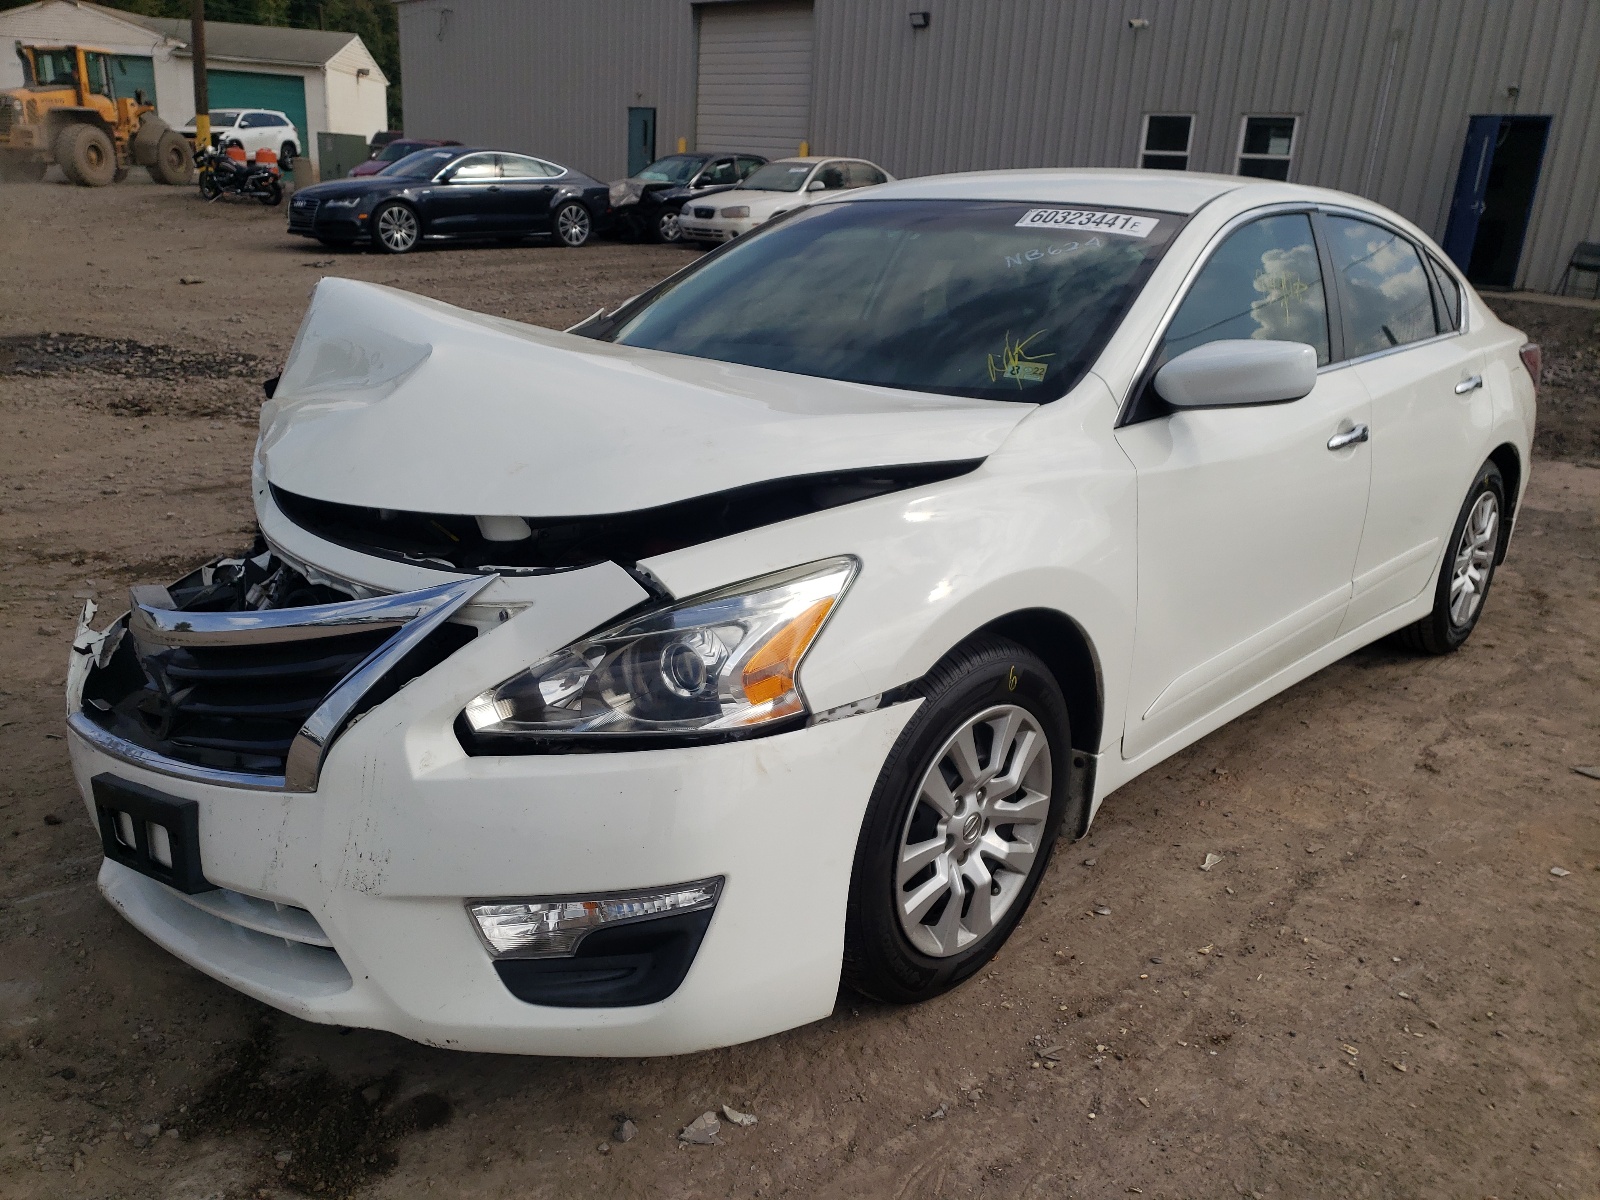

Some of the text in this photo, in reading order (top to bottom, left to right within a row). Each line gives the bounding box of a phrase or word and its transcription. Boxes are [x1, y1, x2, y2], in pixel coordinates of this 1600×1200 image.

[1030, 210, 1133, 230] 60323441
[1032, 366, 1045, 376] 22
[1009, 665, 1018, 691] 6
